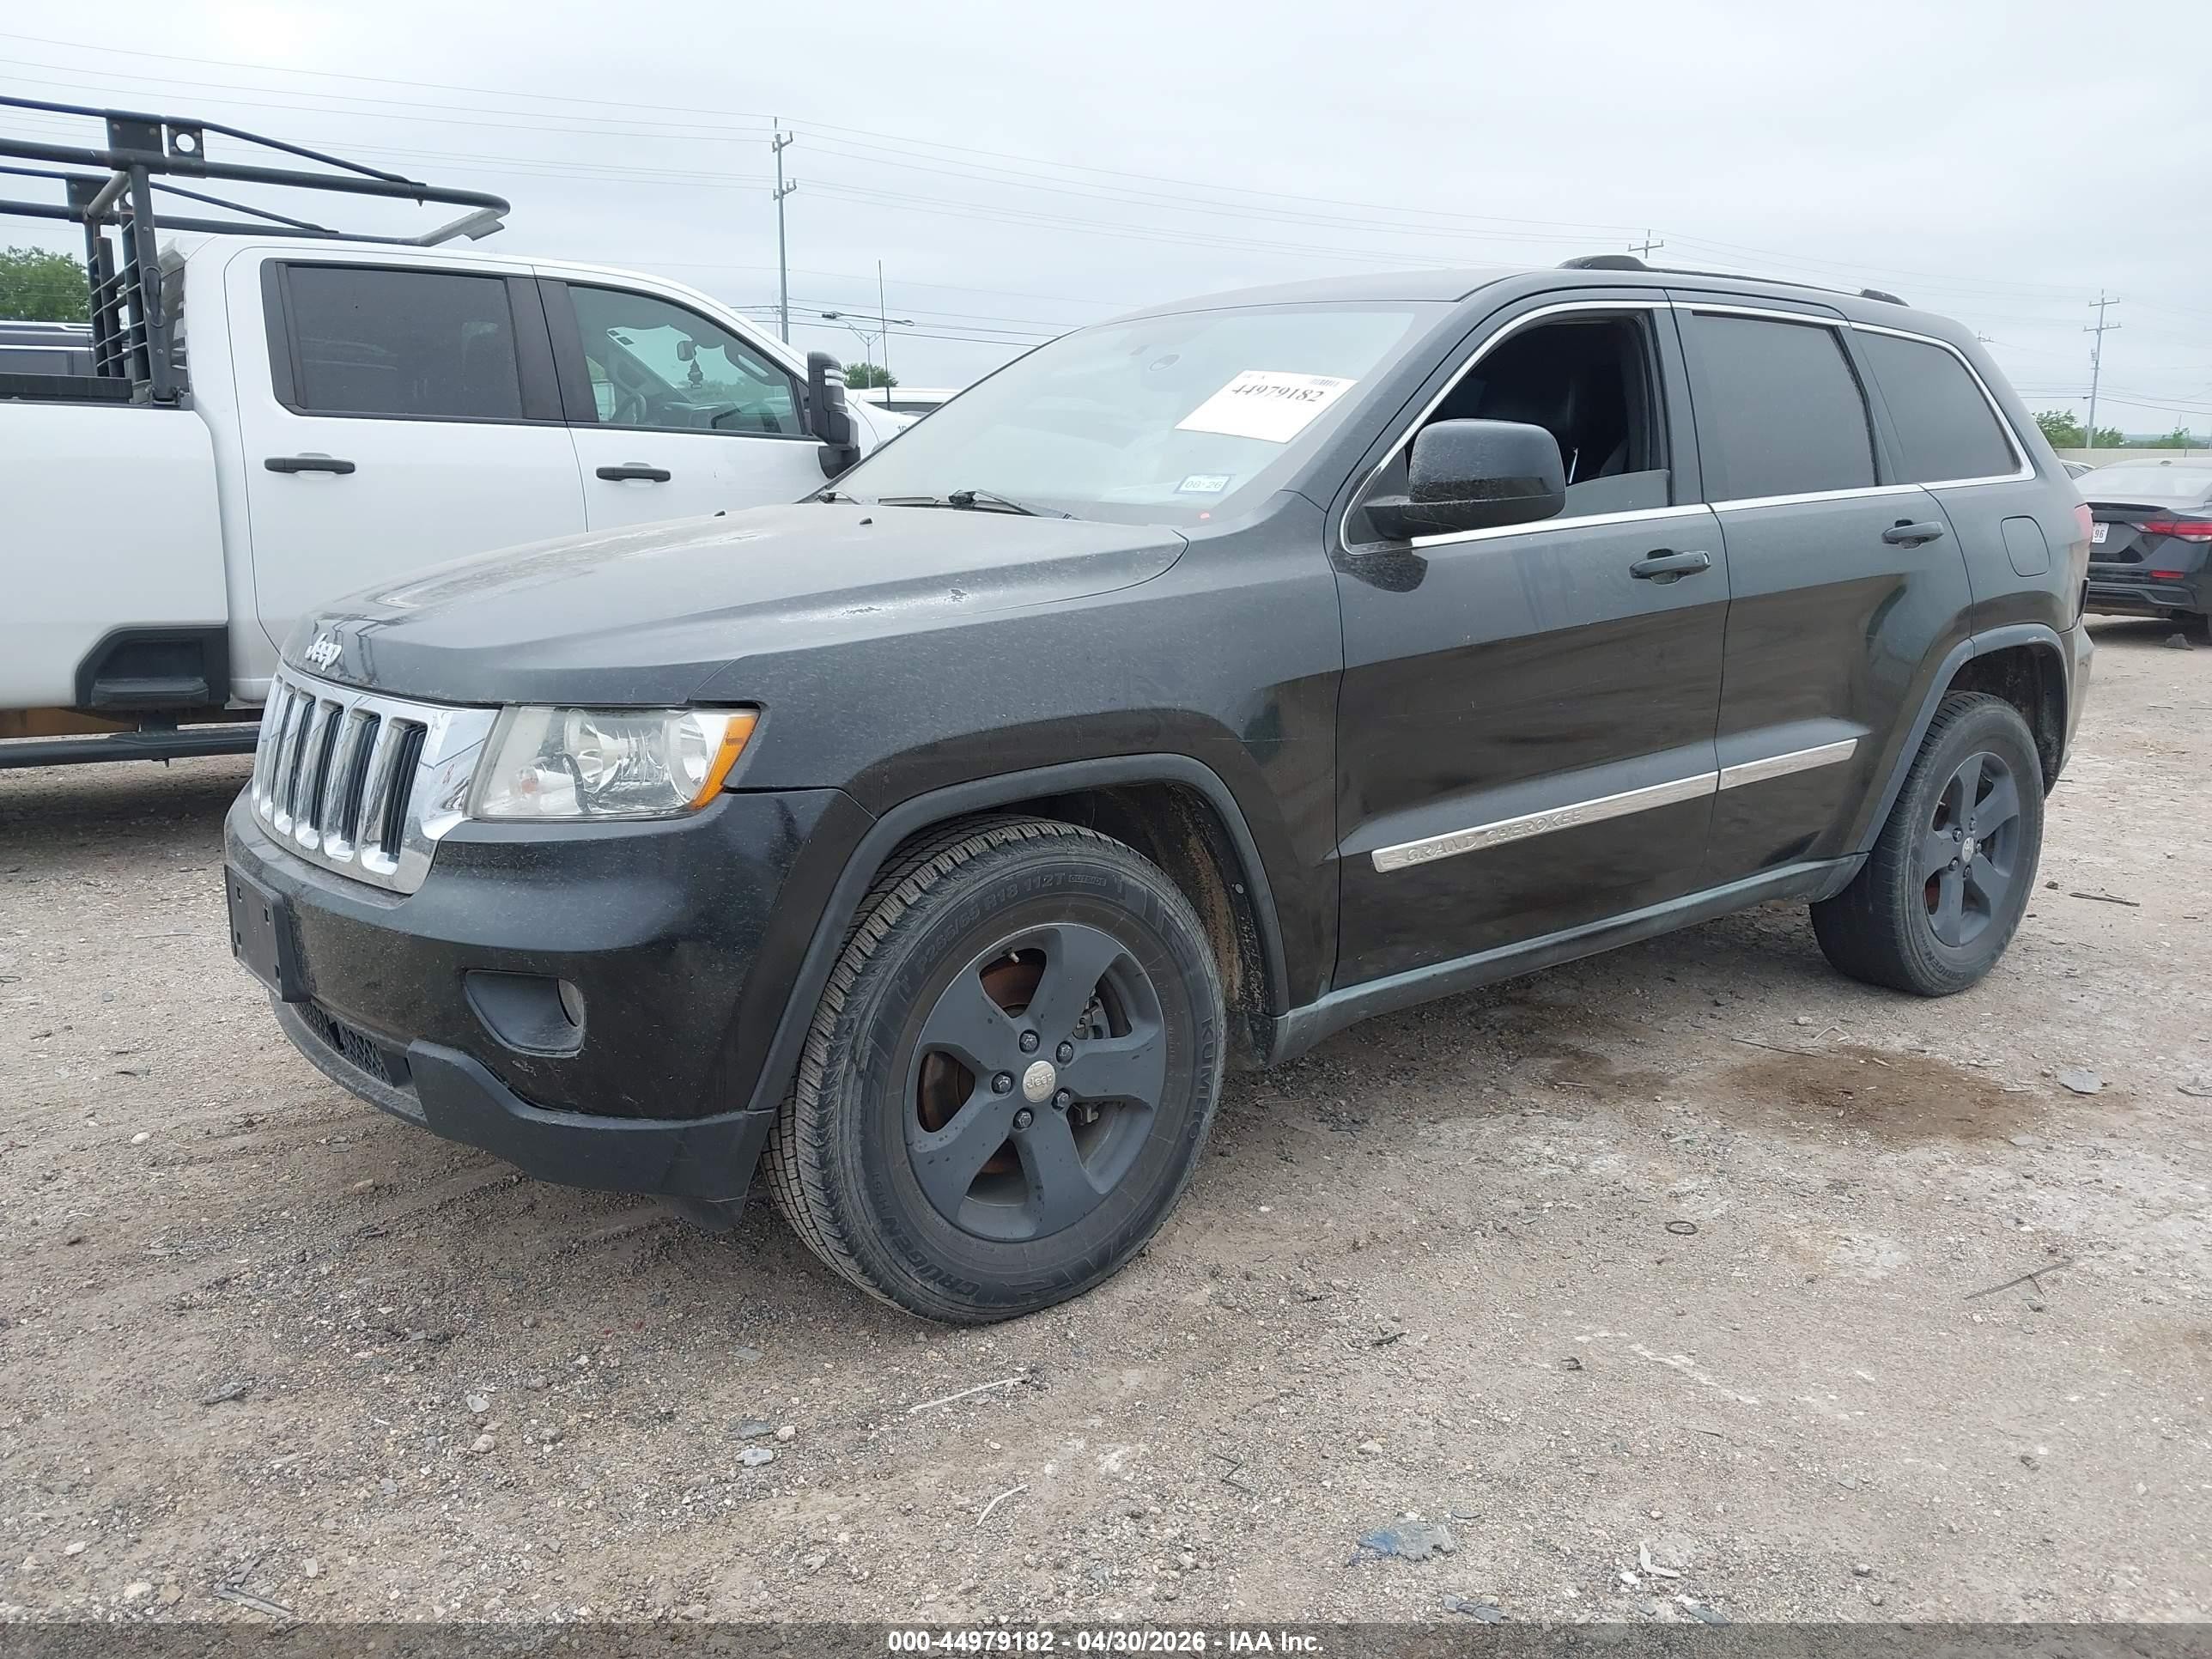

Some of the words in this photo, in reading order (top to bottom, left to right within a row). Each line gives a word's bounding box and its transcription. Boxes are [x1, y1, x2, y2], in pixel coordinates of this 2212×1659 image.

[1232, 384, 1324, 402] 44979182
[304, 633, 343, 672] Jeep
[1406, 832, 1477, 862] GRAND
[1485, 808, 1583, 847] CHEROKEE
[1069, 875, 1106, 886] OUTSIDE
[1026, 1073, 1053, 1089] Jeep
[1188, 1017, 1214, 1139] KUMHO
[879, 1216, 981, 1297] CRUGEN
